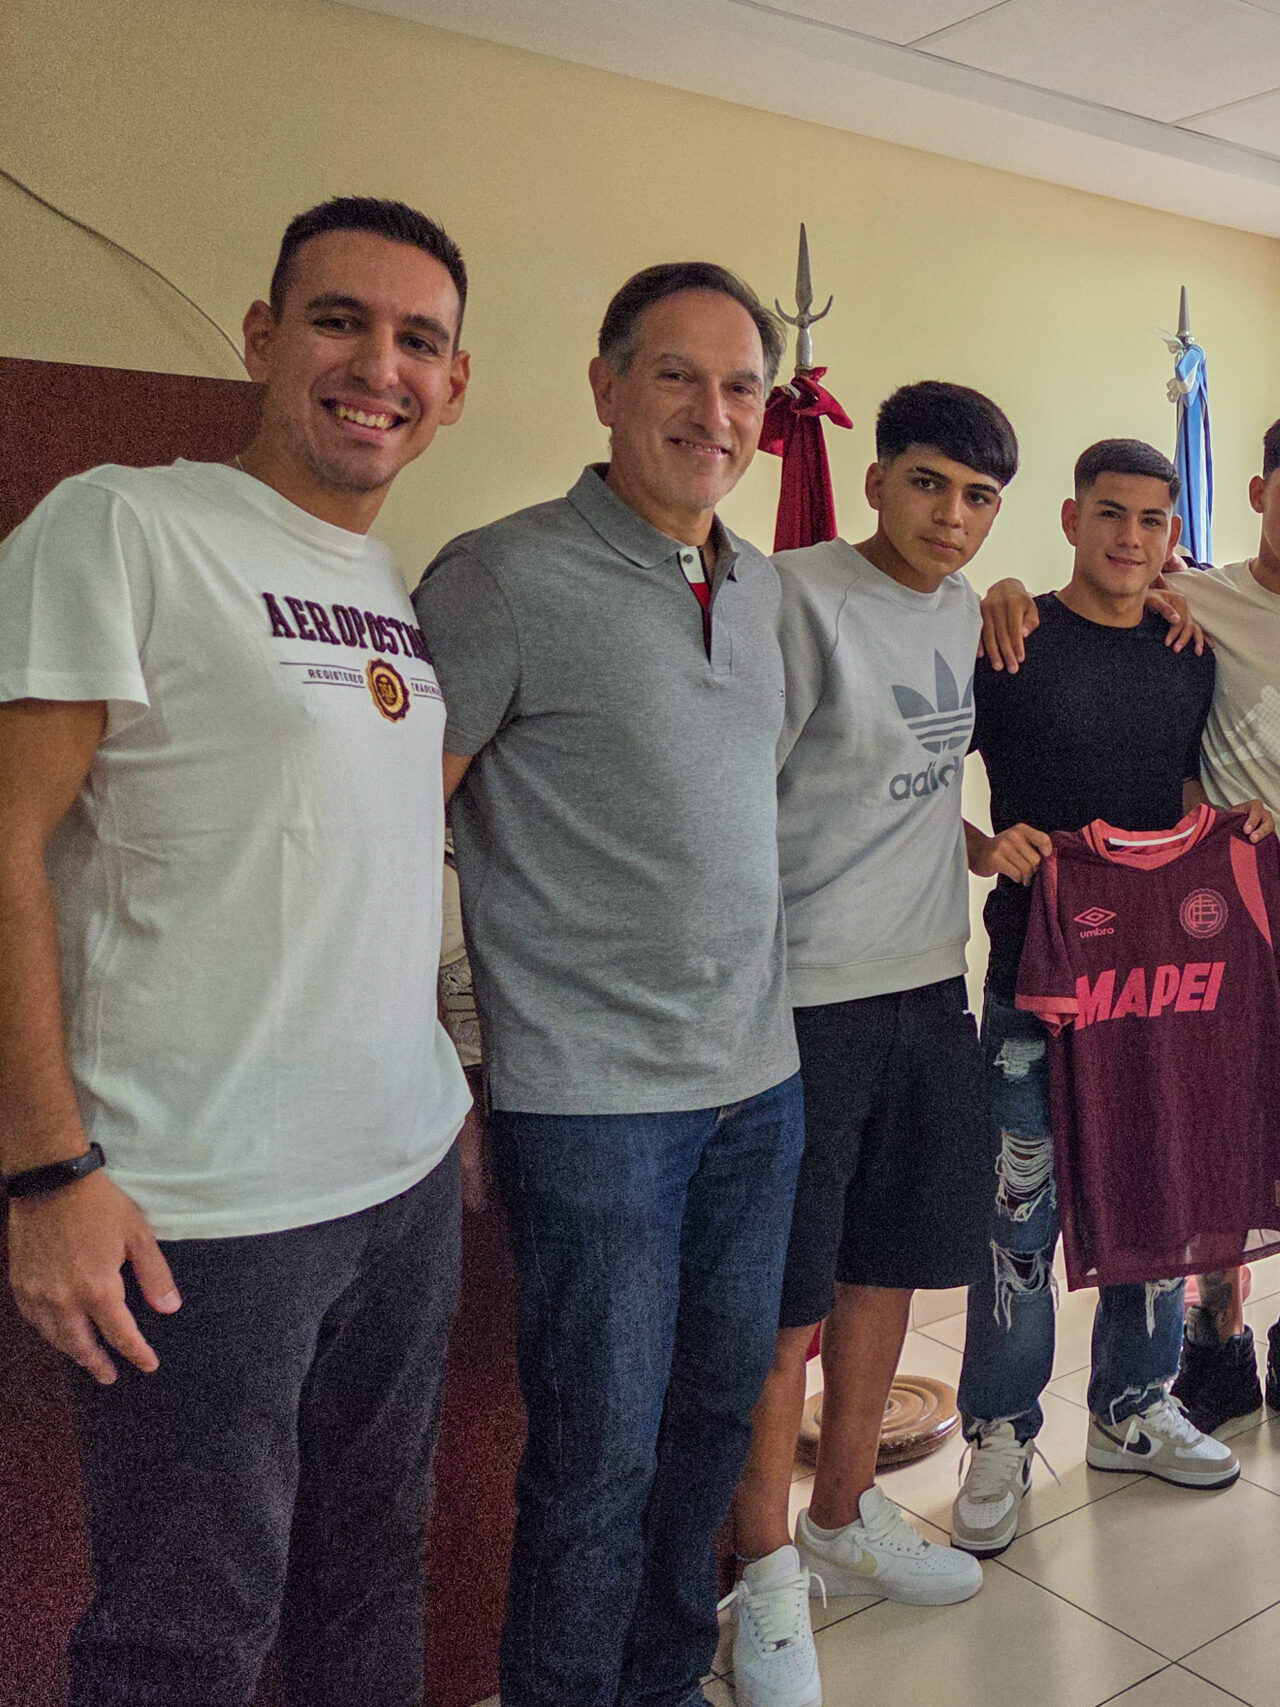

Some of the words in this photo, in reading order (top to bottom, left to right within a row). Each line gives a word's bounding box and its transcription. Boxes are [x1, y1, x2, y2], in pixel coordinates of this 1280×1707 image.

[307, 668, 364, 685] REGISTERED
[1080, 927, 1115, 939] umbro
[1074, 961, 1226, 1031] MAPEI
